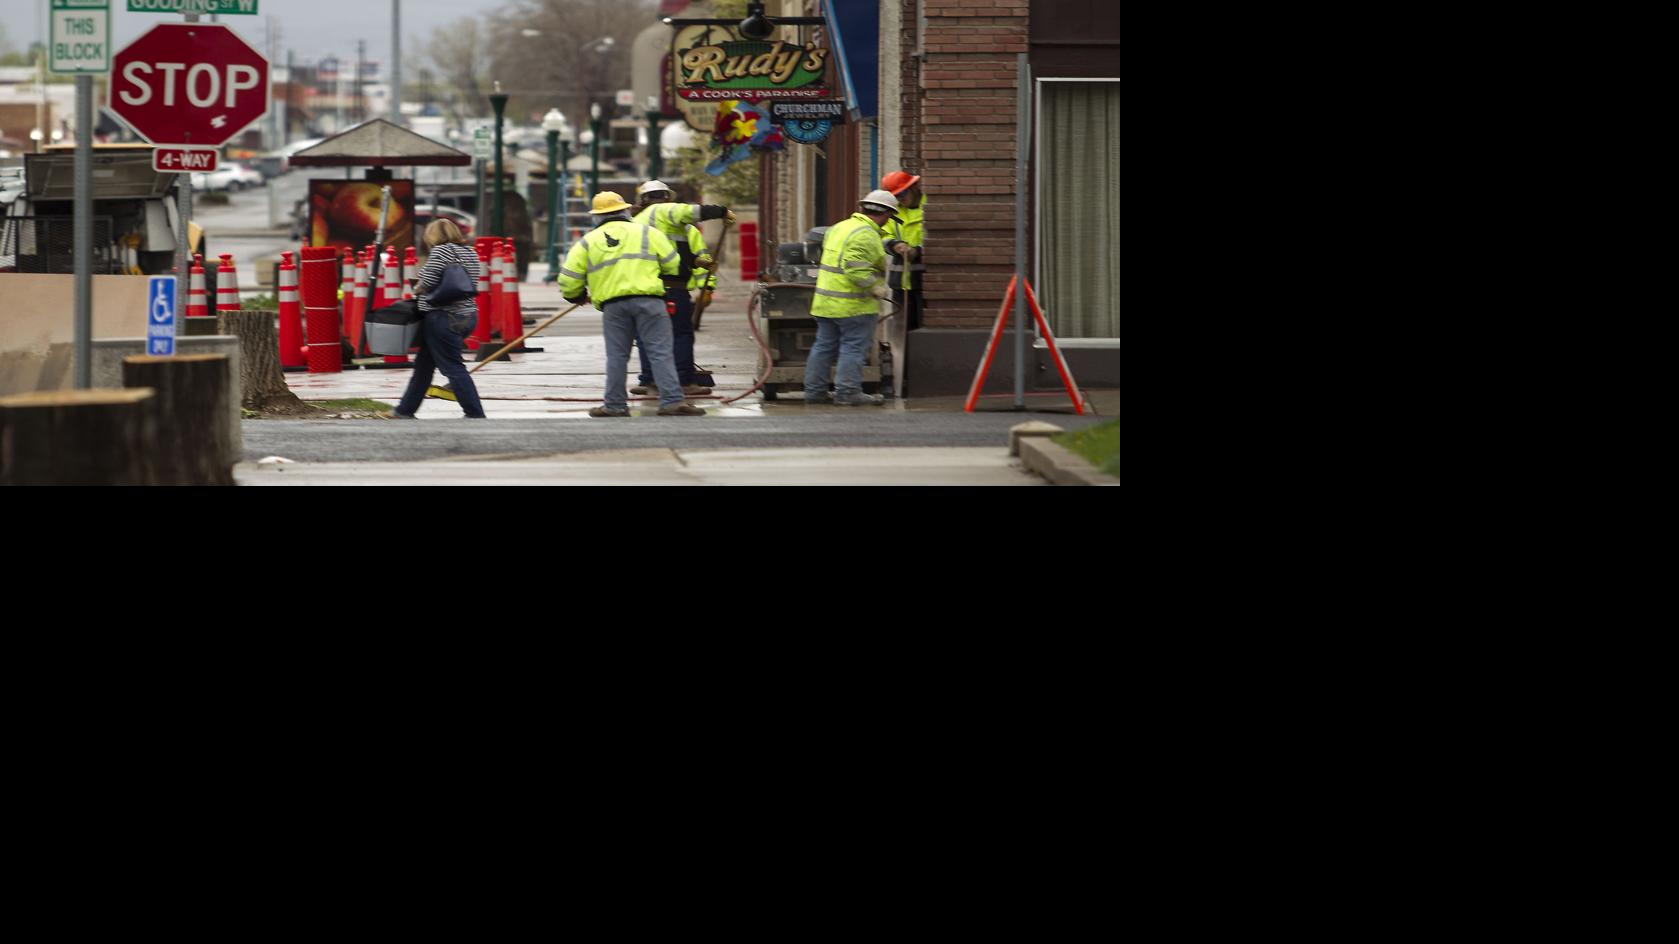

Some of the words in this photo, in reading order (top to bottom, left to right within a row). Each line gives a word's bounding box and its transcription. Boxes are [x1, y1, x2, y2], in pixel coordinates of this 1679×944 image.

[130, 0, 219, 11] GOODING
[64, 17, 95, 36] THIS
[55, 42, 103, 60] BLOCK
[682, 40, 828, 84] Rudy's
[119, 60, 260, 108] STOP
[688, 90, 700, 98] A
[702, 89, 753, 99] COOK'S
[755, 90, 821, 98] PARADISE
[773, 103, 842, 116] CHURCHMAN
[160, 152, 212, 168] 4-WAY
